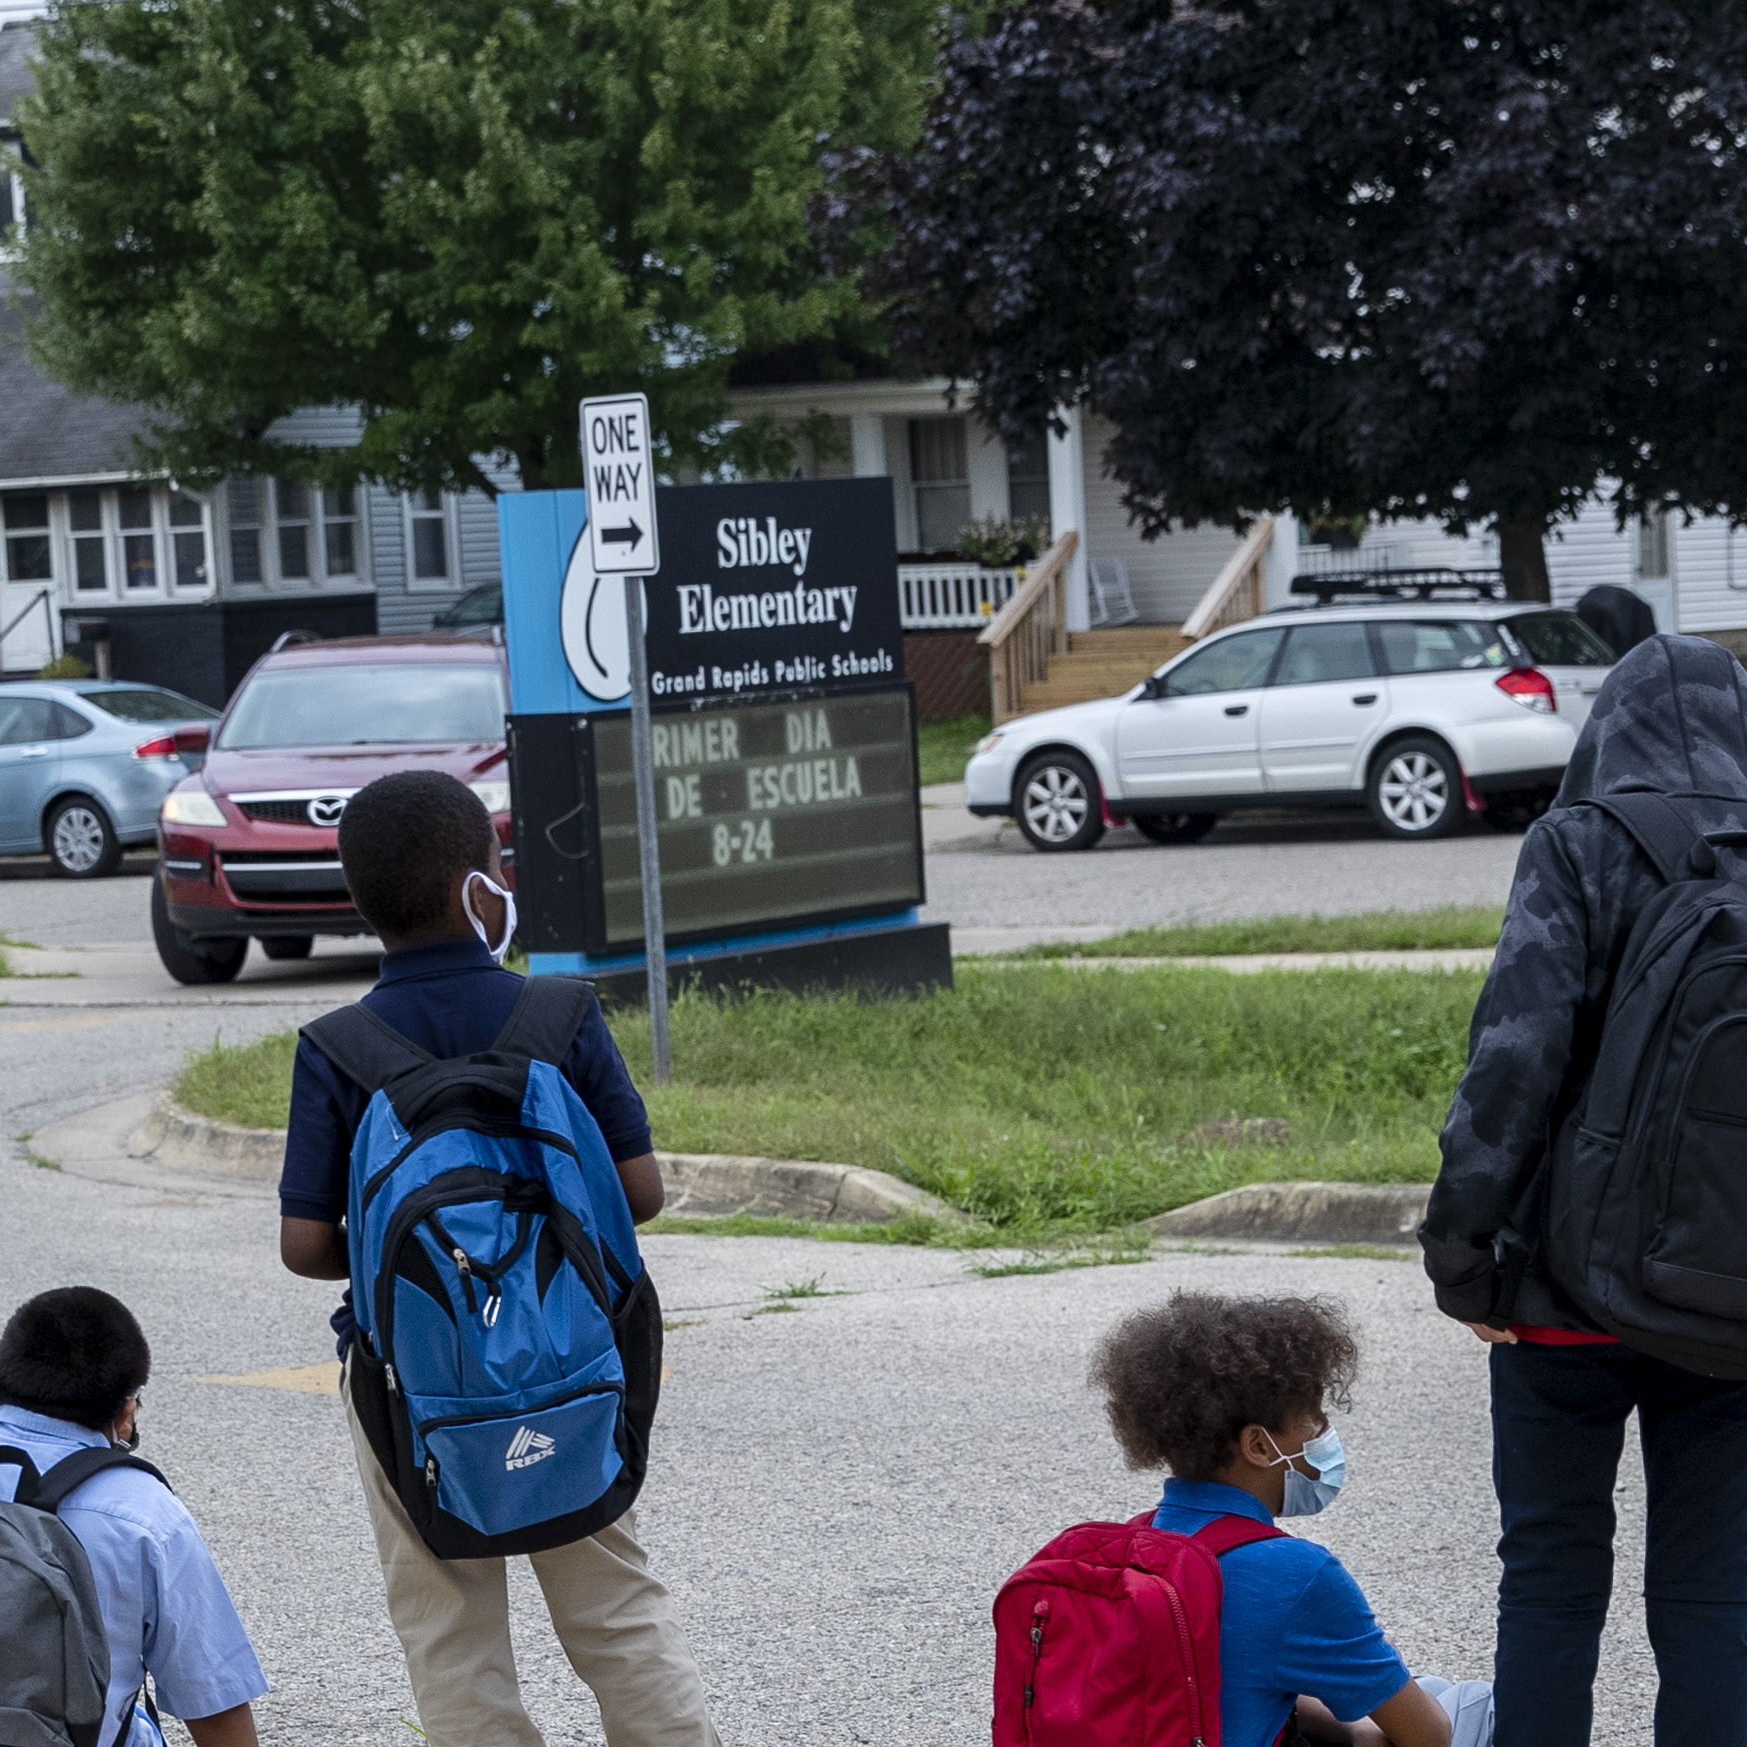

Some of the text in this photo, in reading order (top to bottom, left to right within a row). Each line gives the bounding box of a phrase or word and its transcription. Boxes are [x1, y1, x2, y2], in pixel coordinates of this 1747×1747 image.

[592, 414, 640, 454] ONE
[593, 462, 642, 503] WAY
[716, 516, 813, 576] Sibley
[676, 579, 858, 634] Elementary
[652, 648, 893, 695] Grand Rapids Public Schools
[652, 708, 833, 768] RIMER DIA
[666, 756, 863, 820] DE ESCUELA
[712, 818, 775, 867] 8-24
